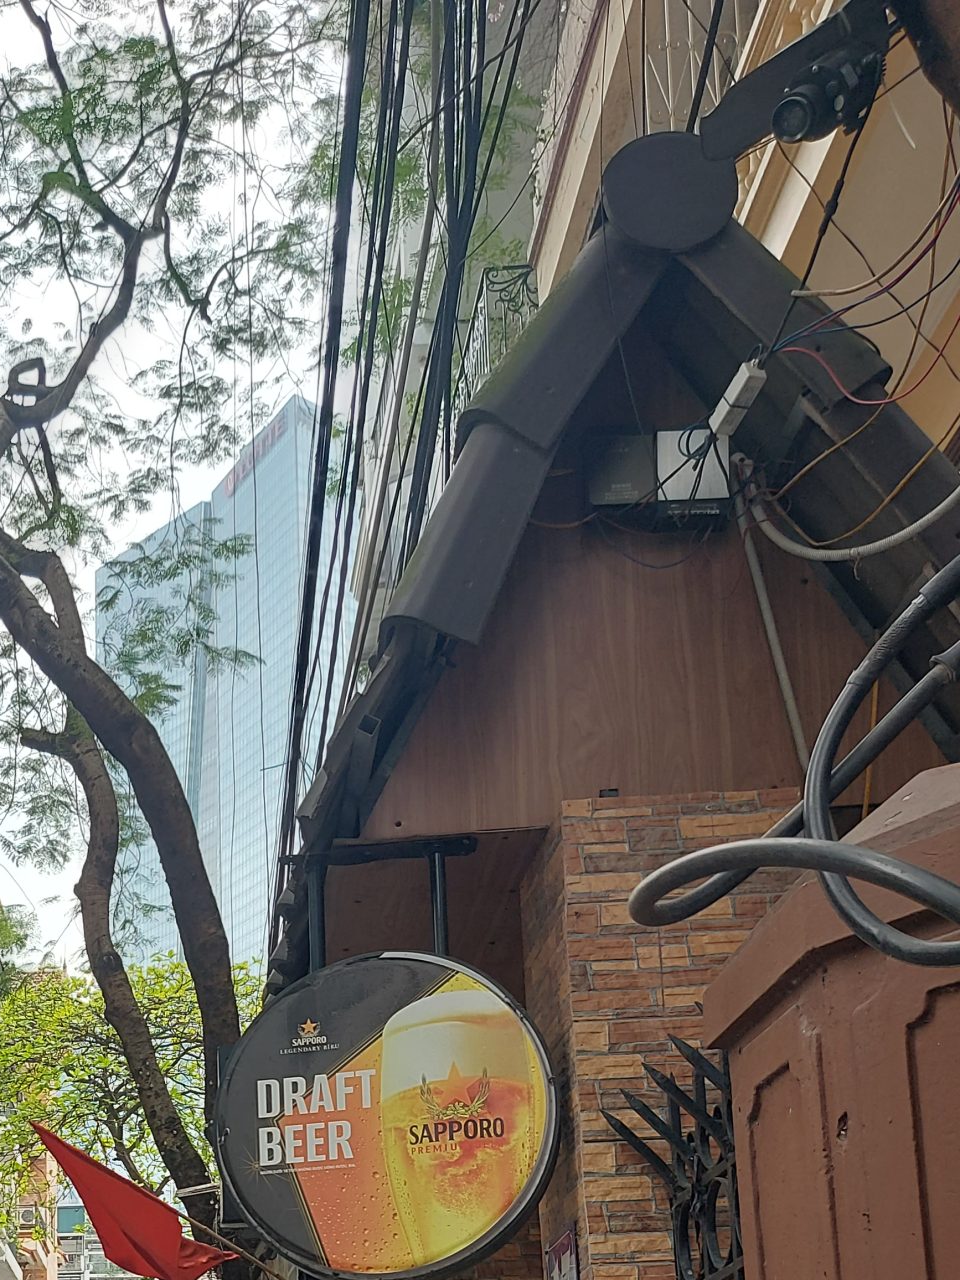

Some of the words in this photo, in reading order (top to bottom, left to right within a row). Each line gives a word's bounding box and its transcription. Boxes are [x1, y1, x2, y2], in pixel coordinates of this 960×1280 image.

[280, 1045, 321, 1055] LEGENDARY
[292, 1035, 327, 1047] SAPPORO
[257, 1069, 376, 1118] DRAFT
[409, 1117, 505, 1146] SAPPORO
[258, 1120, 354, 1167] BEER
[411, 1142, 458, 1155] PREMIU
